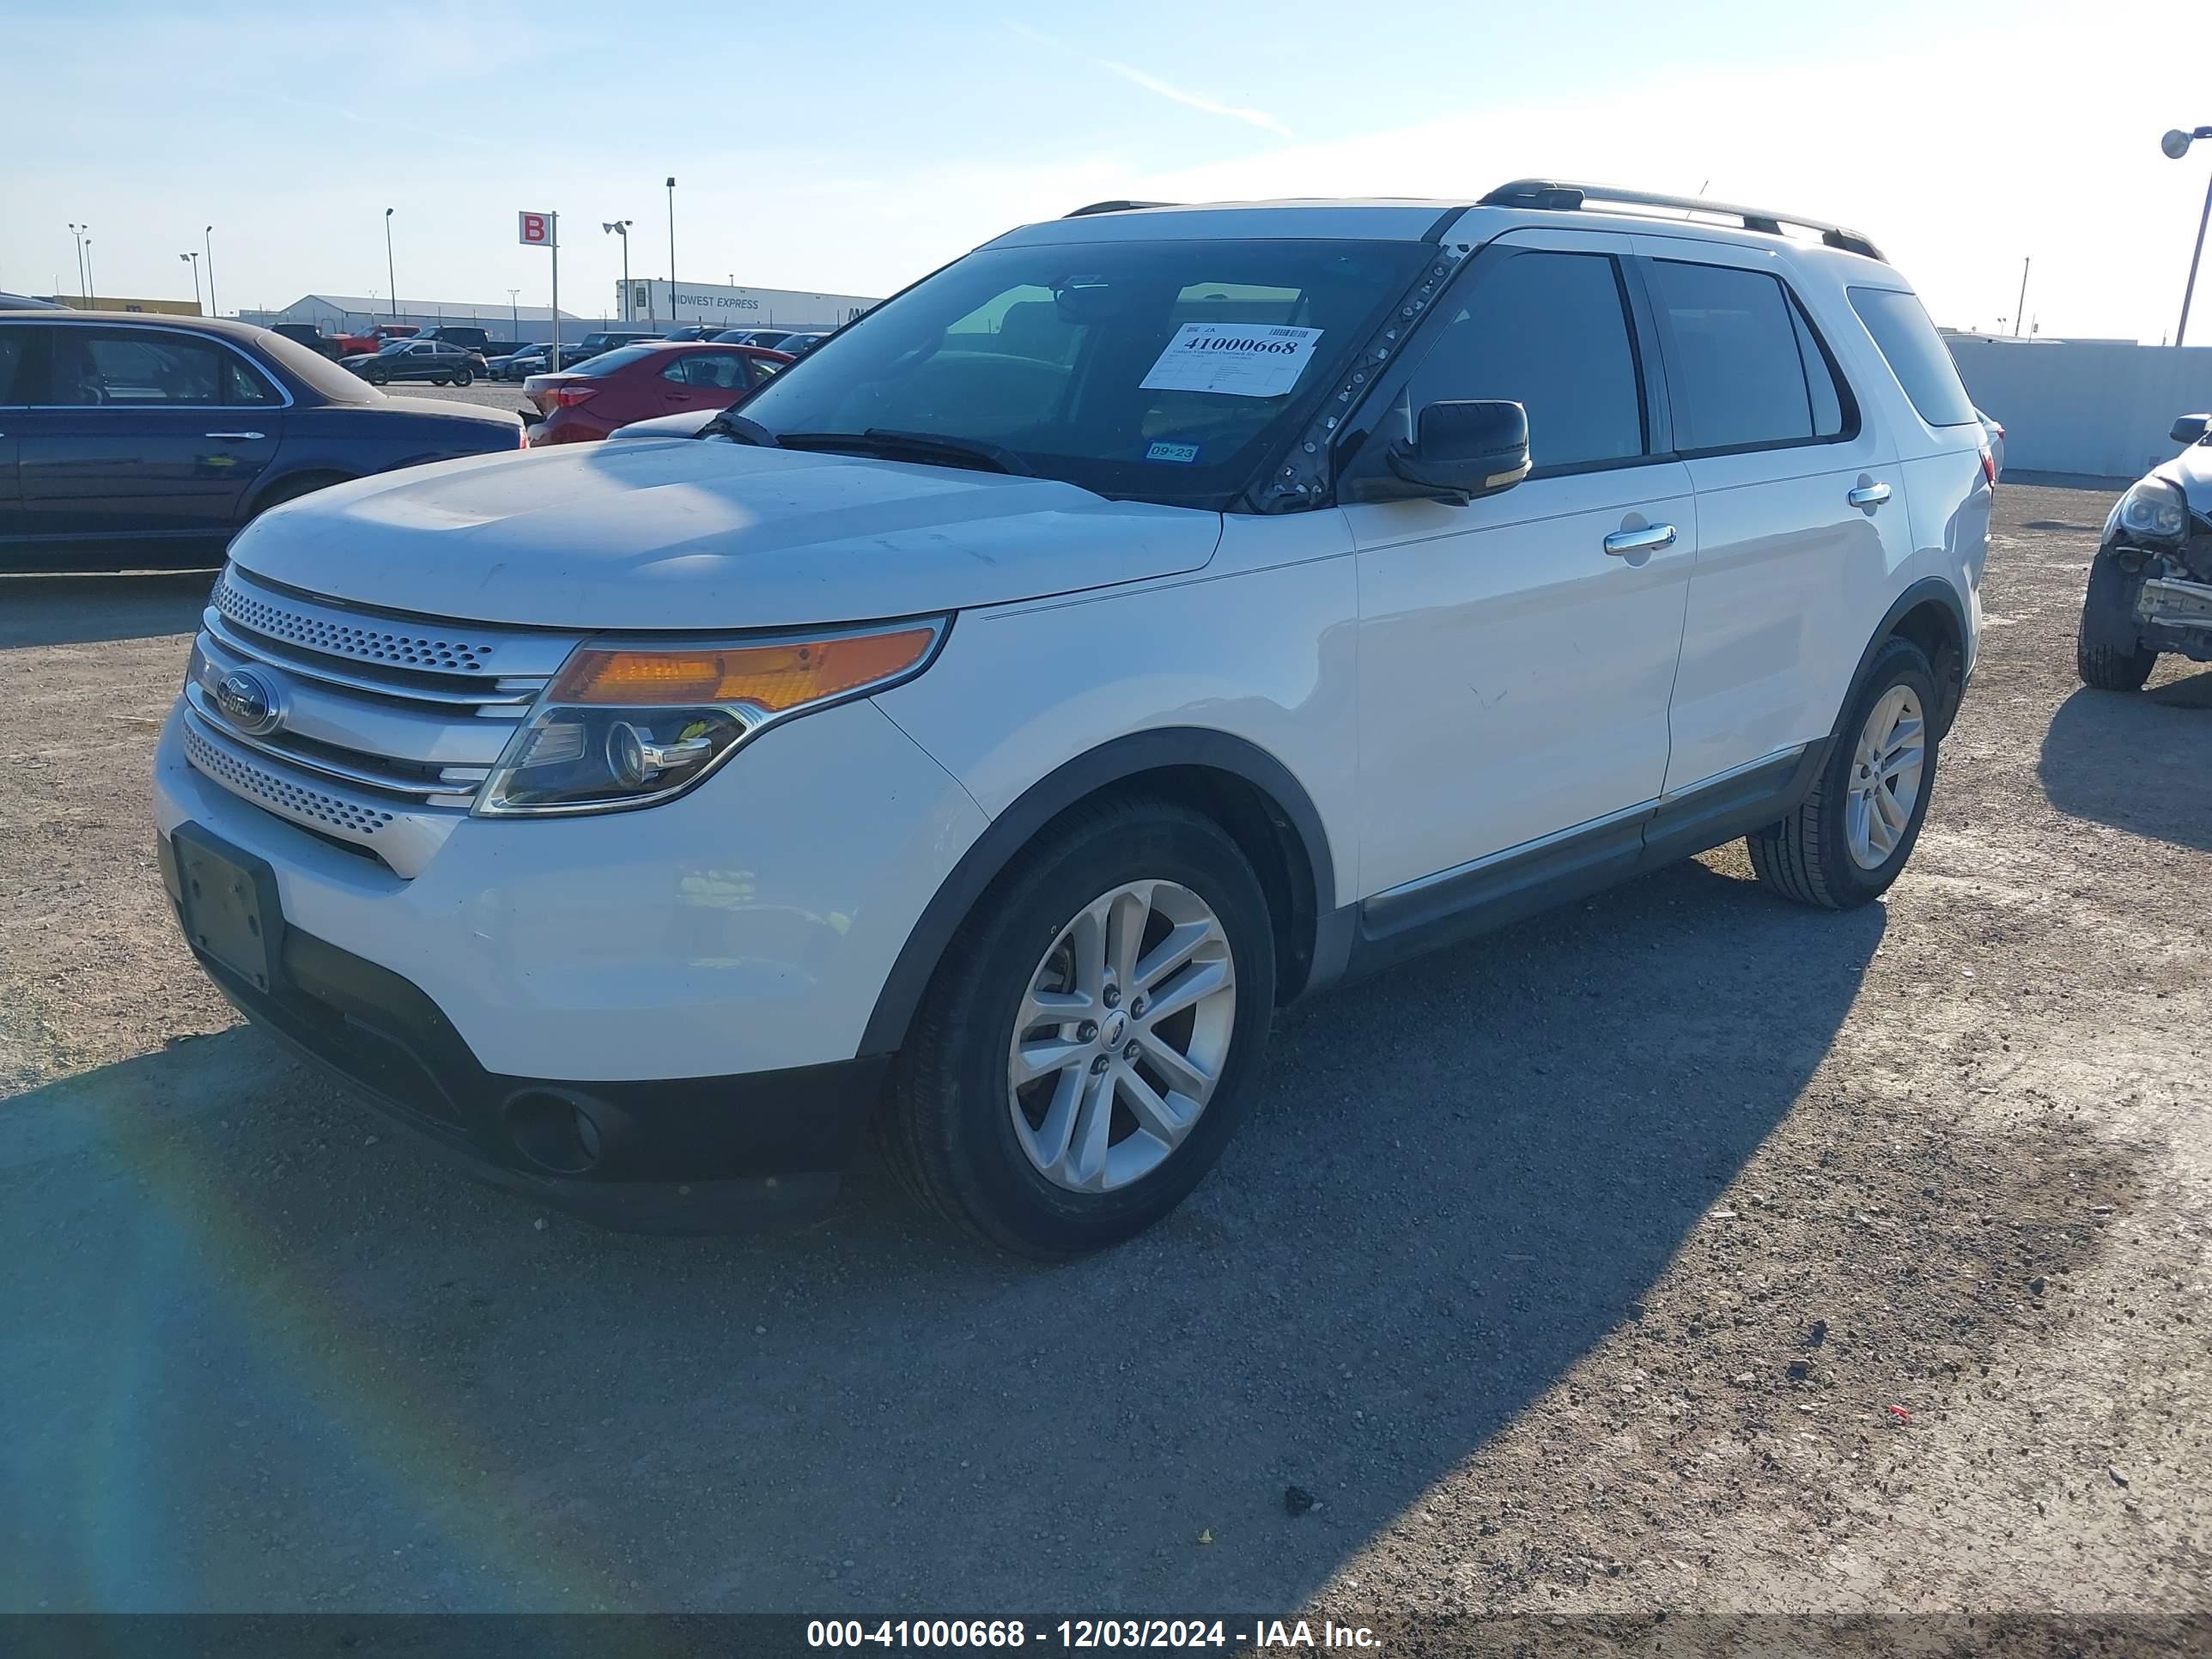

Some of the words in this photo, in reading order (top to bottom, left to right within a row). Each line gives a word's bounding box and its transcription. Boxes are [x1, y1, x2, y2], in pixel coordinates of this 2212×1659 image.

[525, 216, 544, 241] B
[668, 294, 714, 307] MIDWEST
[717, 297, 759, 310] EXPRESS
[1184, 337, 1299, 356] 41000668
[220, 677, 255, 716] Ford
